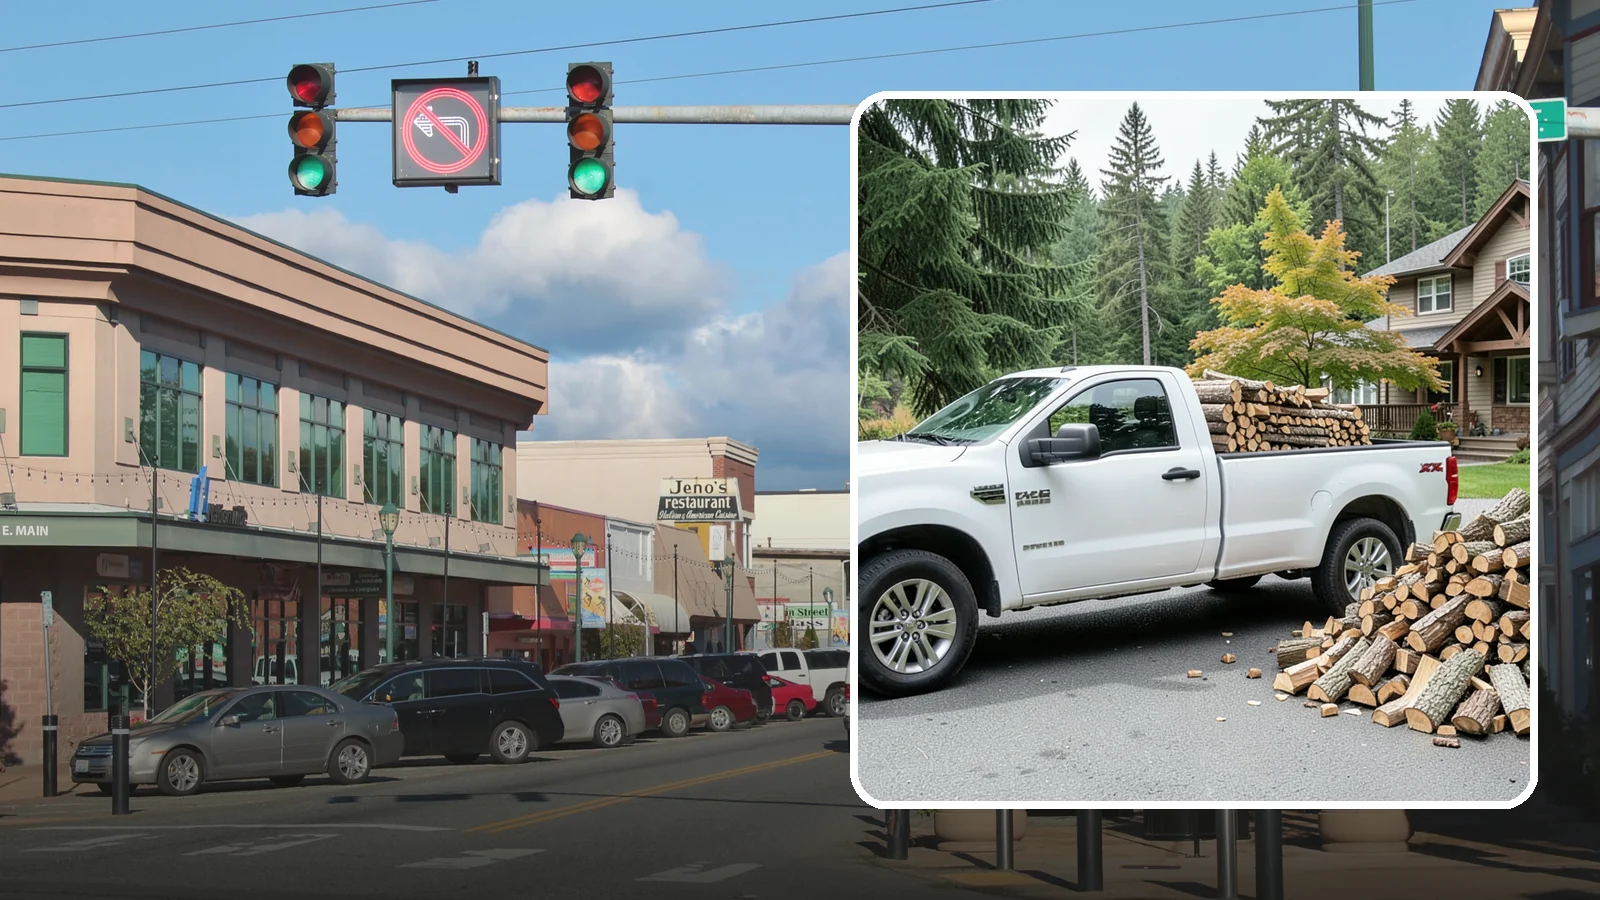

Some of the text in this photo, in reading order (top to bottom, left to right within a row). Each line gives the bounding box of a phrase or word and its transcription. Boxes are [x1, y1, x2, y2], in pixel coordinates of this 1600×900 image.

[670, 480, 727, 495] Jeno's
[665, 496, 731, 509] restaurant
[658, 510, 681, 519] Italian
[686, 509, 714, 519] American
[715, 509, 738, 519] Cuisine
[2, 525, 49, 536] E. MAIN
[797, 607, 828, 617] Street
